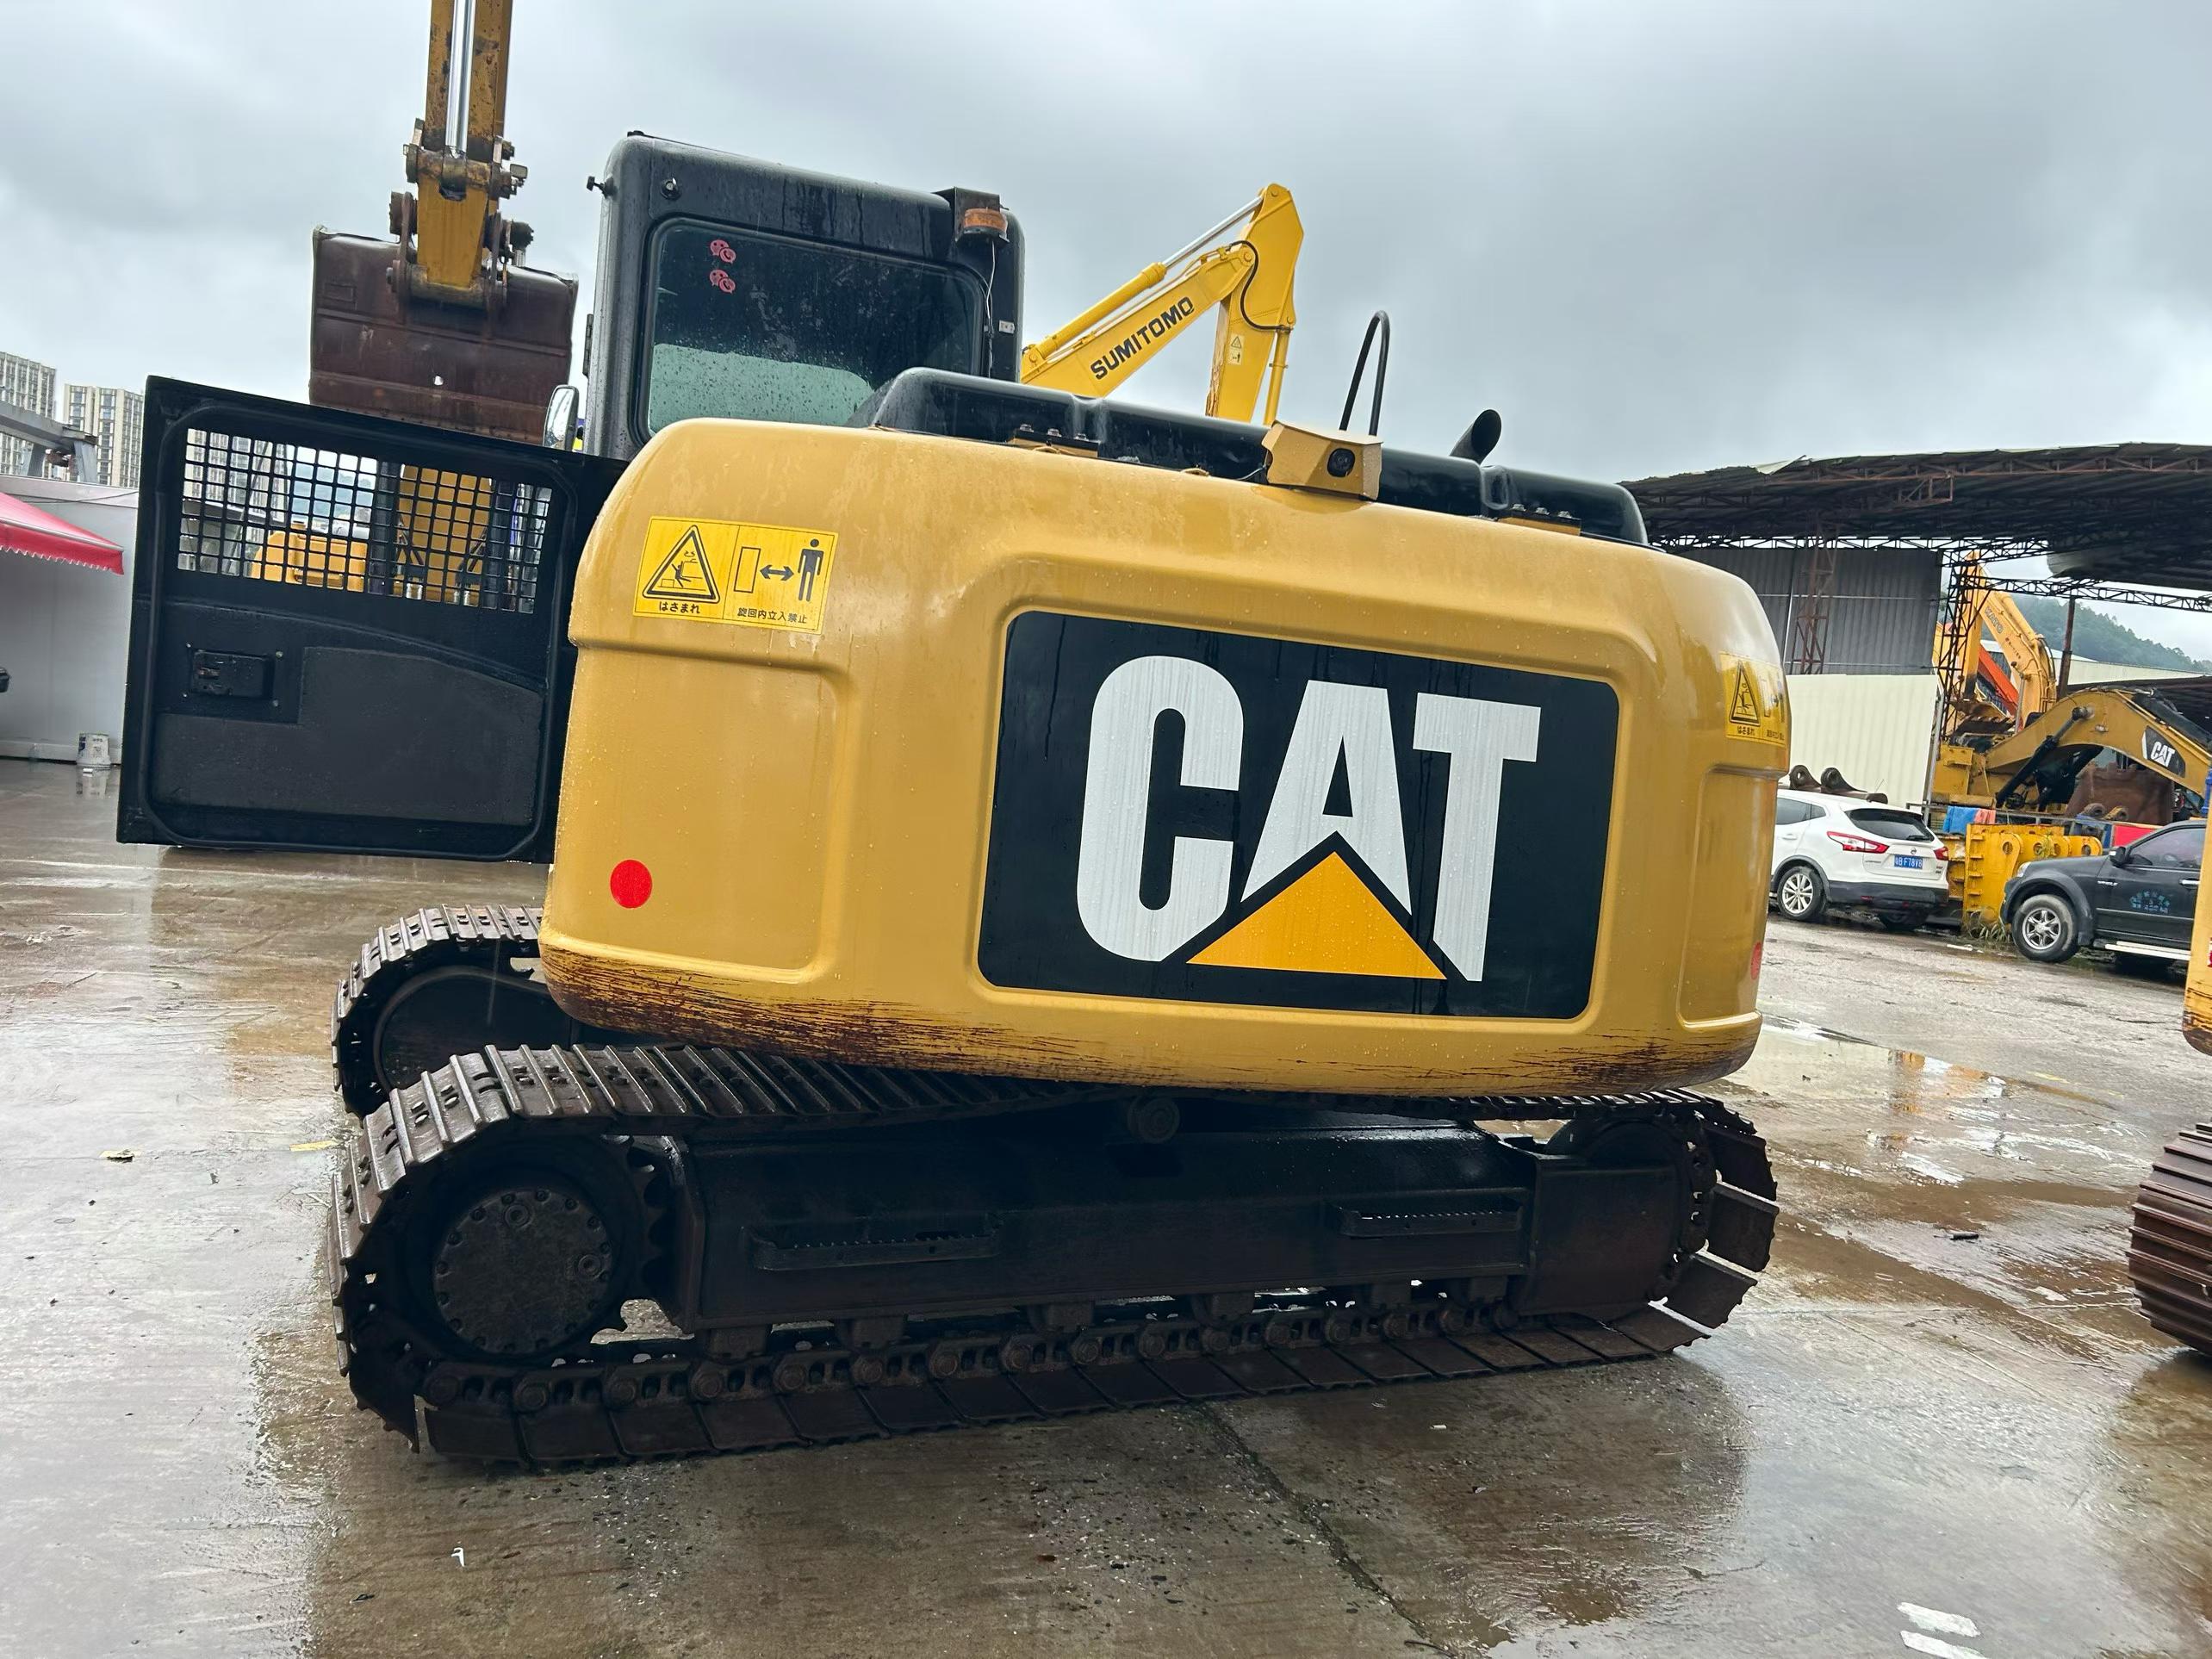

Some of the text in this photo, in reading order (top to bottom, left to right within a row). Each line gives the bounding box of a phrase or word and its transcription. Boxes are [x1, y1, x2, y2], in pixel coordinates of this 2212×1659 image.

[1090, 296, 1195, 380] SUMITOMO
[659, 600, 700, 614] はさまれ
[2150, 741, 2176, 767] CAT
[1077, 656, 1541, 982] CAT
